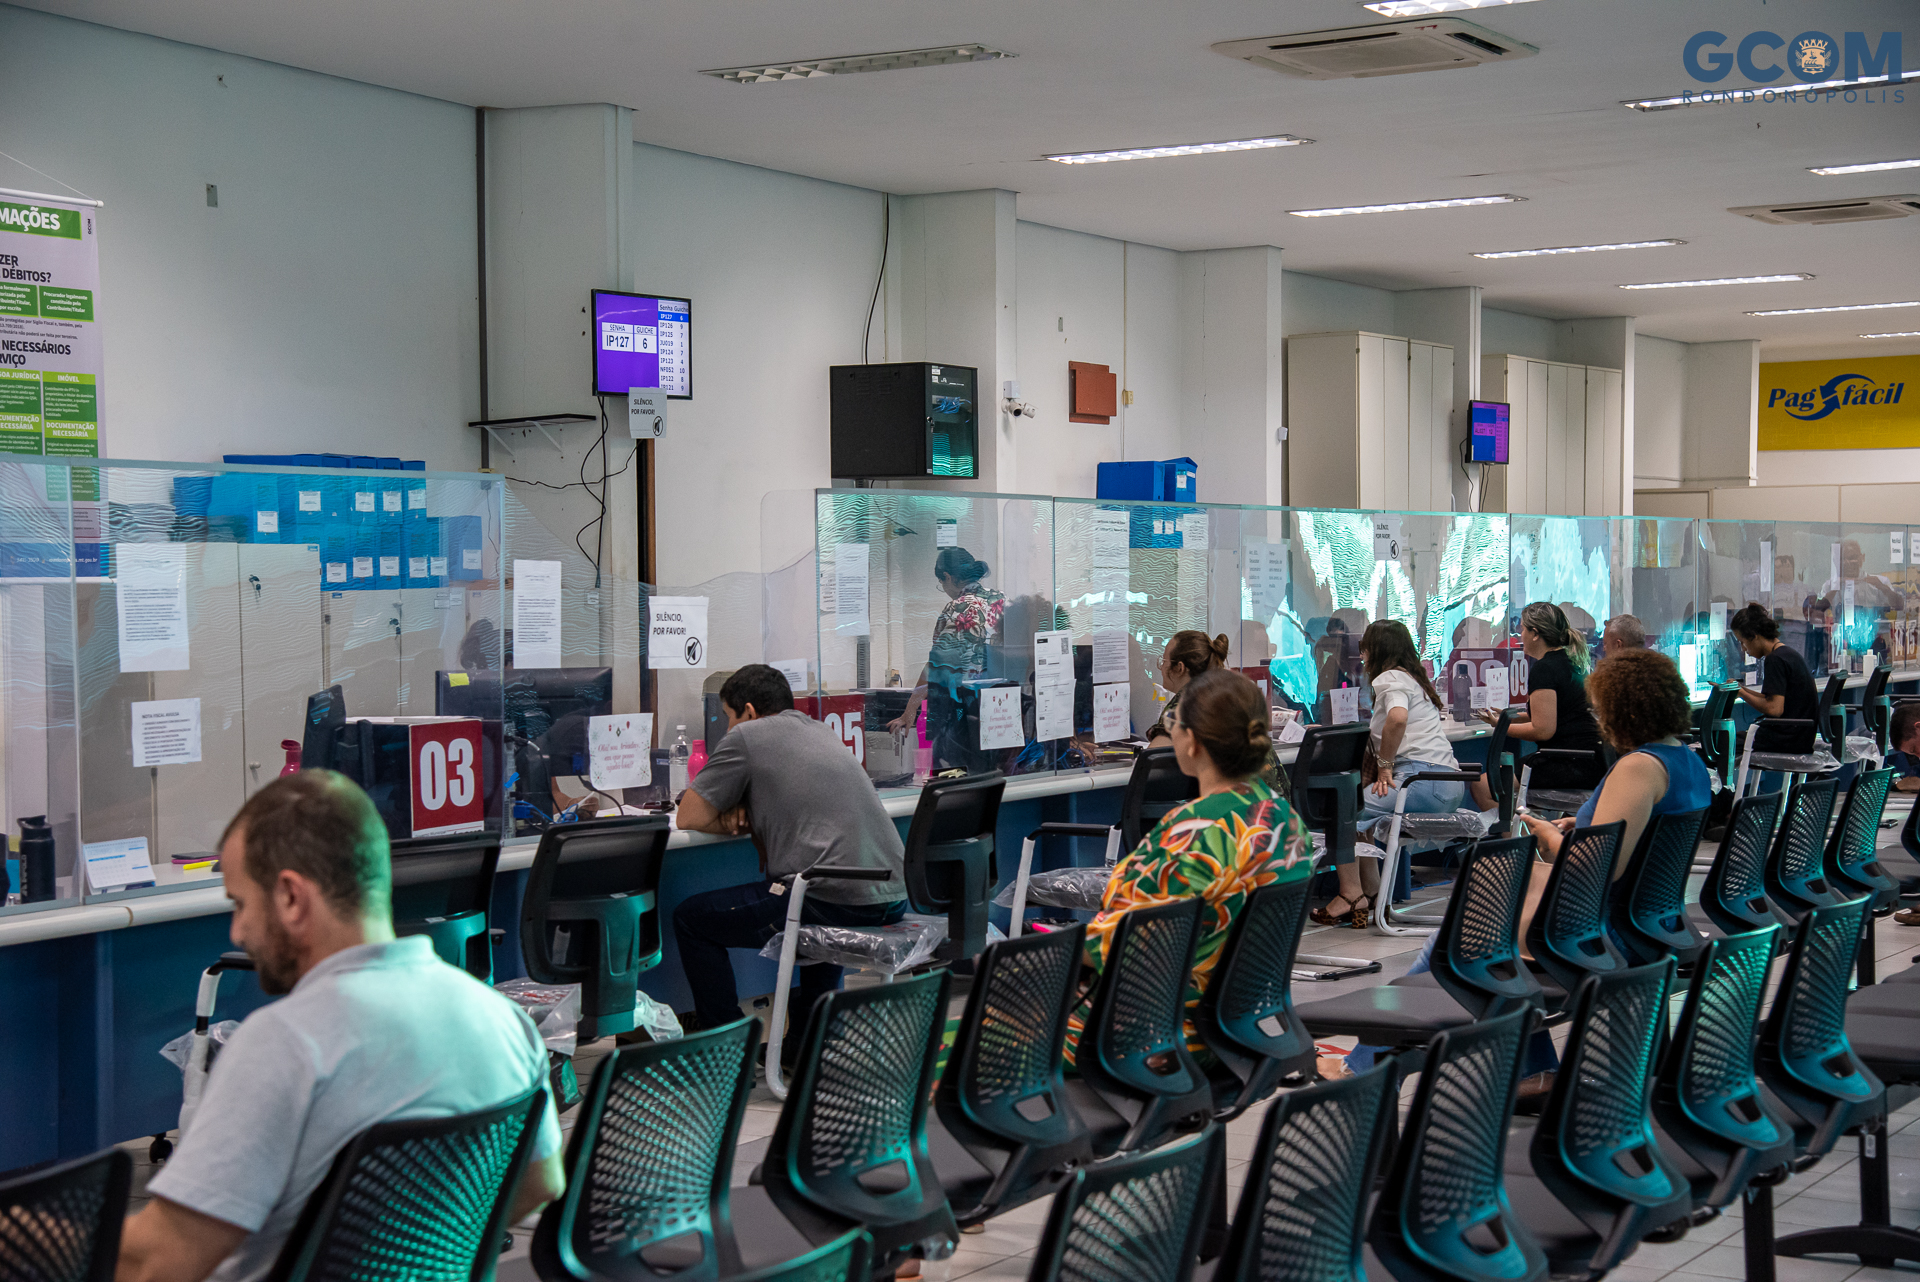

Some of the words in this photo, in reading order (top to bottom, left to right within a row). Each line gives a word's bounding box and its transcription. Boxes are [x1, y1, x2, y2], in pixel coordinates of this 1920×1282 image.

[2, 265, 52, 283] DÉBITOS?
[610, 324, 625, 332] SENHA
[606, 334, 629, 348] IP127
[642, 337, 648, 350] 6
[2, 340, 72, 355] NECESSÁRIOS
[11, 370, 40, 380] JURÍDICA
[57, 374, 80, 382] IMÓVEL
[633, 398, 653, 406] SILÊNCIO,
[1768, 388, 1817, 412] Pag
[1842, 382, 1904, 406] fácil
[46, 422, 95, 431] DOCUMENTAÇÃO
[52, 428, 88, 437] NECESSÁRIA
[656, 612, 683, 622] SILÊNCIO,
[653, 627, 665, 635] POR
[666, 627, 686, 635] FAVOR!
[1510, 658, 1528, 697] 09
[420, 738, 475, 811] 03
